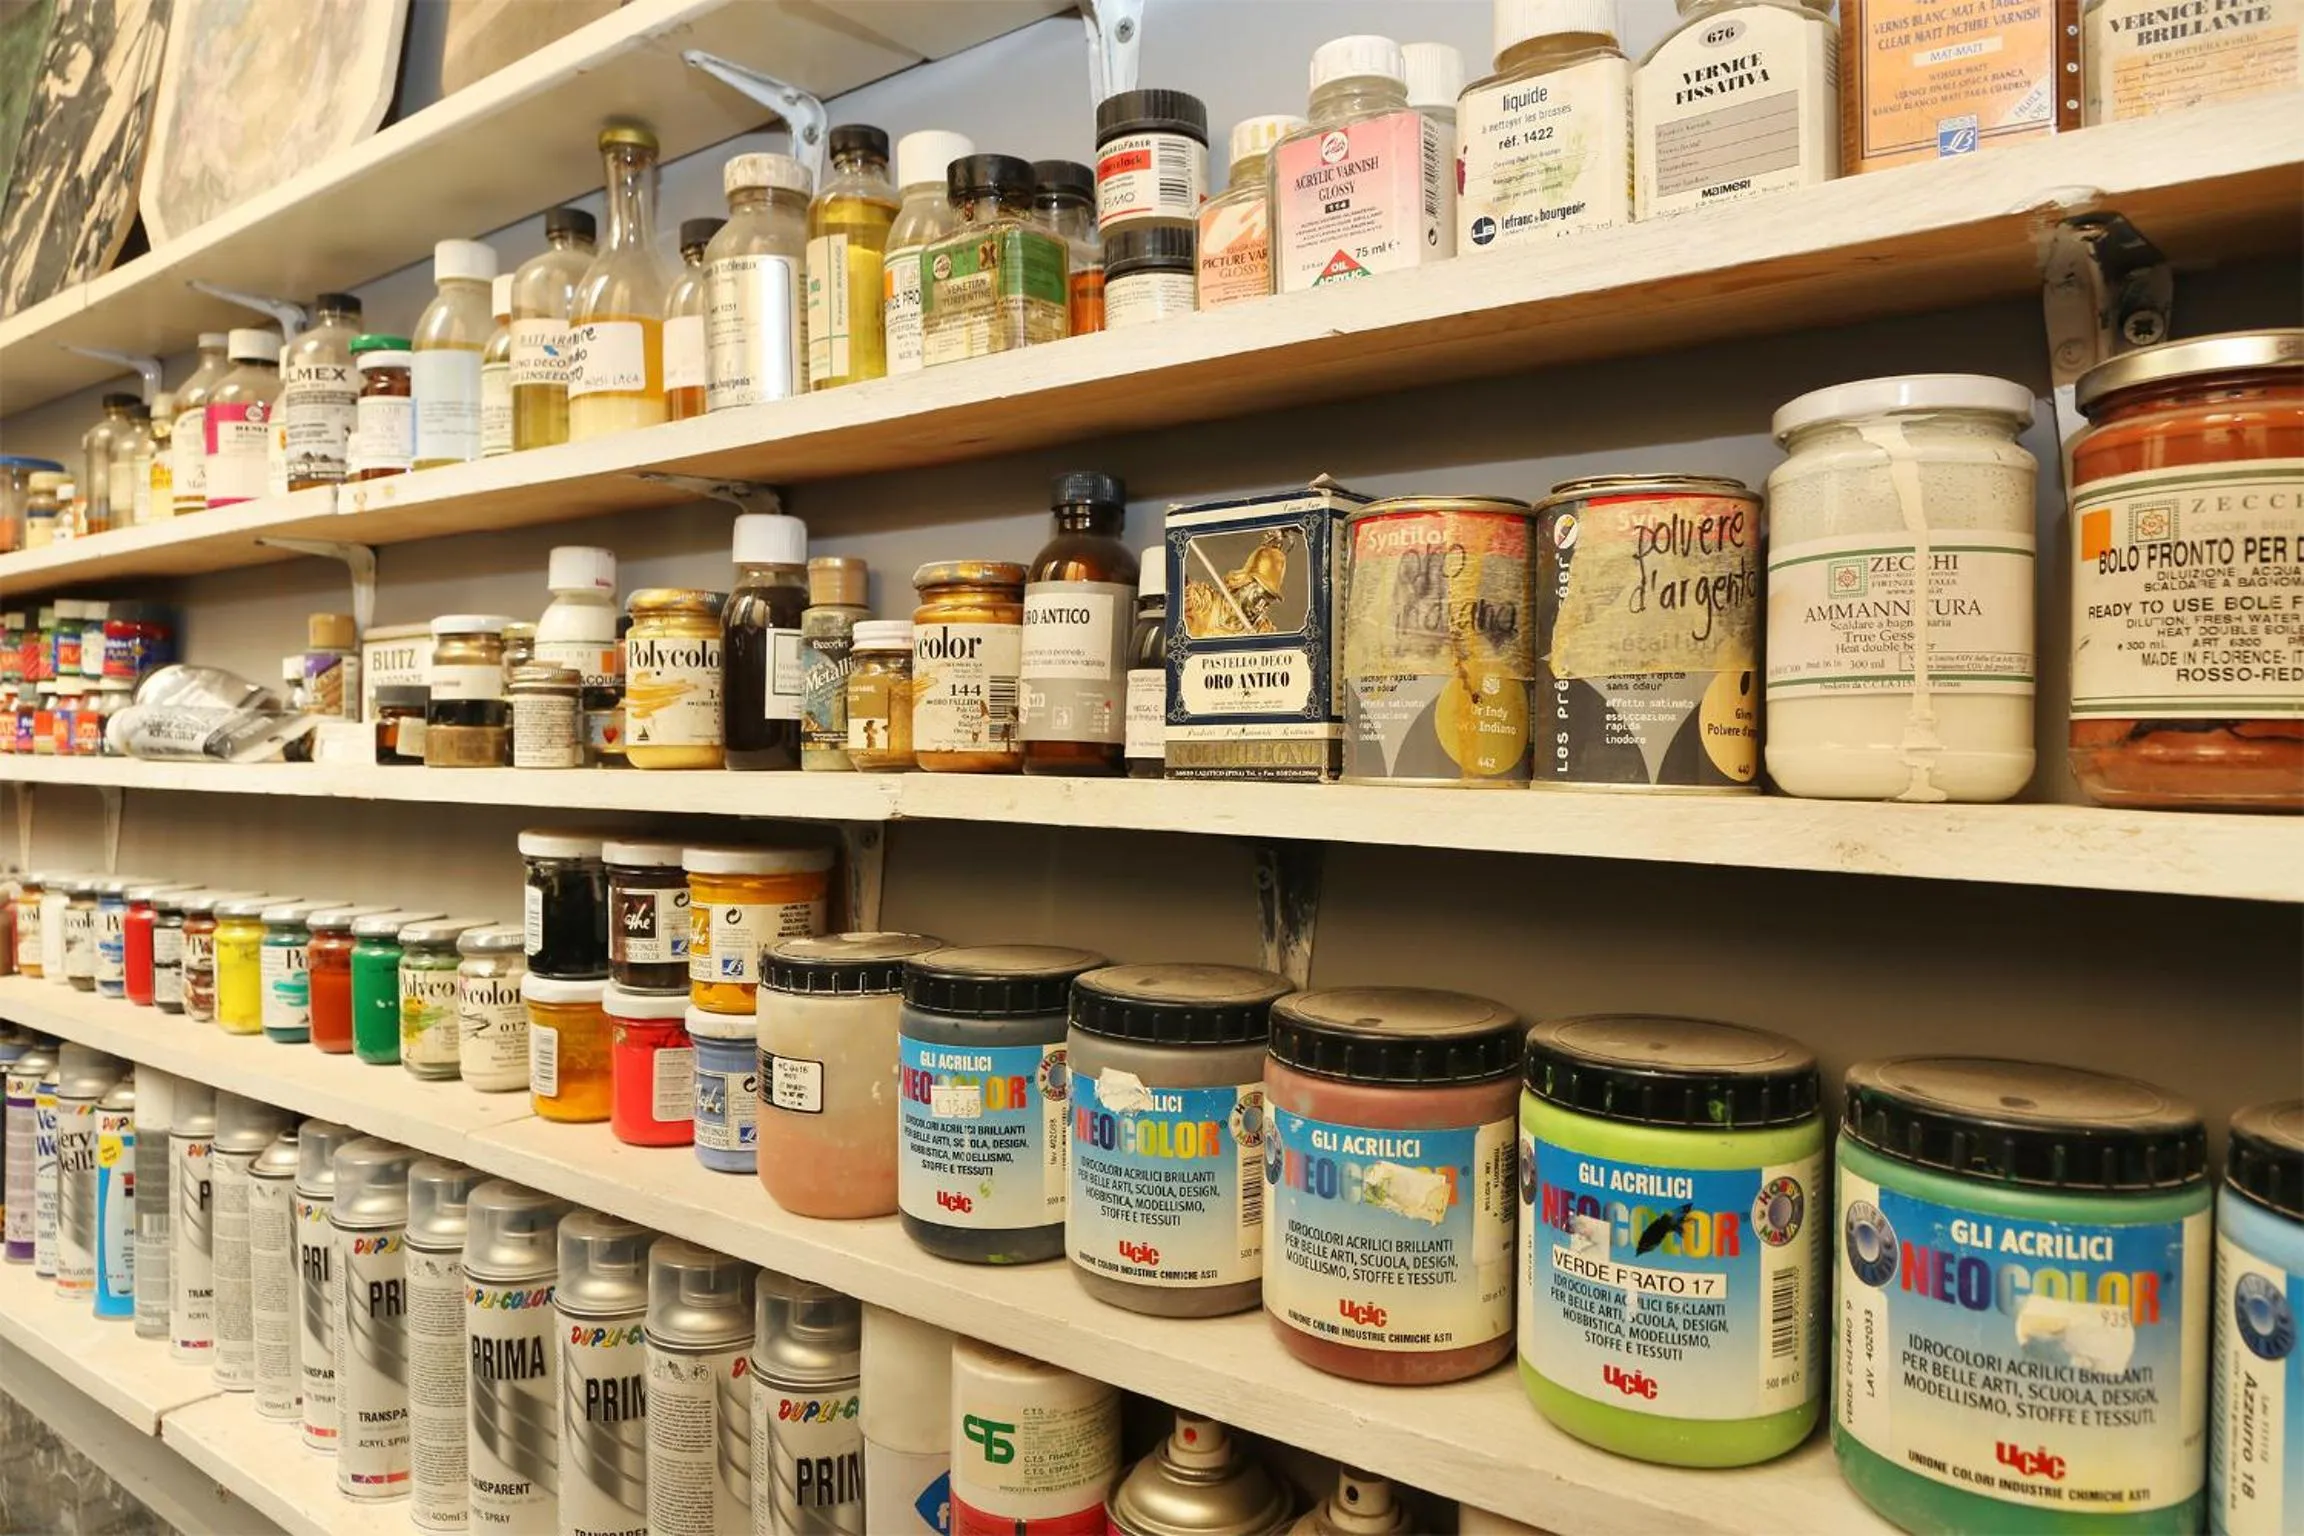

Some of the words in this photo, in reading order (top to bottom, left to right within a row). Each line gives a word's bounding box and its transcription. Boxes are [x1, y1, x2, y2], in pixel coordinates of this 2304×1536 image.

[1878, 34, 1911, 50] CLEAR
[1914, 26, 1943, 43] MATT
[1946, 20, 1989, 37] PICTURE
[1993, 8, 2042, 27] VARNISH
[2109, 1, 2207, 32] VERNICE
[2137, 5, 2271, 46] BRILLANTE
[1707, 27, 1735, 44] 676
[1683, 52, 1763, 85] VERNICE
[1503, 86, 1548, 112] liquide
[1676, 68, 1770, 105] FISSATIVA
[1524, 127, 1554, 144] 1422
[1294, 171, 1335, 191] ACRYLIC
[1337, 156, 1380, 181] VARNISH
[1318, 181, 1355, 201] GLOSSY
[1202, 253, 1246, 269] PICTURE
[1356, 247, 1368, 259] 75
[1372, 242, 1386, 255] ml
[1633, 506, 1745, 559] polvere
[2099, 545, 2139, 575] BOLO
[2244, 536, 2287, 563] PER
[2088, 602, 2132, 619] READY
[2140, 600, 2164, 614] TO
[2172, 597, 2214, 613] USE
[2225, 596, 2283, 611] BOLE
[914, 626, 982, 659] color
[1843, 632, 1876, 643] True
[1880, 630, 1915, 642] Gess
[2157, 626, 2192, 636] HEAT
[2200, 625, 2258, 635] DOUBLE
[2192, 638, 2219, 648] ART
[2229, 638, 2262, 647] 6300
[373, 649, 415, 670] BLITZ
[1863, 641, 1900, 652] double
[2142, 652, 2177, 666] MADE
[2183, 652, 2196, 665] IN
[950, 684, 981, 696] 144
[1204, 674, 1233, 689] ORO
[1240, 672, 1289, 689] ANTICO
[1605, 735, 1647, 745] inodore
[920, 1050, 936, 1067] GLI
[938, 1054, 992, 1072] ACRILICI
[1075, 1107, 1220, 1159] NEOCOLOR
[1312, 1129, 1337, 1152] GLI
[1342, 1135, 1421, 1158] ACRILICI
[921, 1159, 948, 1173] STOFFE
[950, 1163, 954, 1174] E
[957, 1166, 993, 1176] TESSUTI
[1081, 1155, 1122, 1176] IDROCOLORI
[1124, 1168, 1162, 1182] ACRILICI
[1164, 1171, 1215, 1182] BRILLANTI
[1578, 1161, 1605, 1189] GLI
[1610, 1169, 1693, 1200] ACRILICI
[1089, 1174, 1110, 1189] BELLE
[1111, 1179, 1133, 1195] ARTI,
[1135, 1184, 1178, 1199] SCUOLA,
[1101, 1208, 1130, 1222] STOFFE
[1133, 1214, 1138, 1223] E
[1140, 1215, 1181, 1226] TESSUTI
[1135, 1198, 1205, 1213] MODELLISMO,
[1288, 1219, 1344, 1247] IDROCOLORI
[1346, 1235, 1393, 1251] ACRILICI
[1396, 1238, 1453, 1253] BRILLANTI
[1951, 1218, 1992, 1250] GLI
[2000, 1228, 2114, 1262] ACRILICI
[1285, 1233, 1300, 1250] PER
[1301, 1239, 1328, 1257] BELLE
[1331, 1249, 1357, 1266] ARTI,
[1360, 1254, 1410, 1269] SCUOLA,
[1121, 1266, 1157, 1279] INDUSTRIE
[1160, 1271, 1199, 1280] CHIMICHE
[1201, 1270, 1218, 1279] ASTI
[1285, 1249, 1350, 1281] MODELLISMO,
[1353, 1268, 1394, 1285] STOFFE
[1397, 1273, 1404, 1285] E
[1554, 1250, 1610, 1282] VERDE
[1617, 1267, 1685, 1294] PRATO
[1692, 1279, 1715, 1296] 17
[1550, 1286, 1566, 1306] PER
[1568, 1293, 1595, 1314] BELLE
[1598, 1304, 1625, 1322] ARTI,
[1554, 1272, 1611, 1304] IDROCOLORI
[1614, 1293, 1665, 1314] ACILICI
[1288, 1308, 1312, 1327] UNIONE
[1313, 1318, 1339, 1335] COLORI
[1342, 1326, 1386, 1343] INDUSTRIE
[1388, 1332, 1431, 1344] CHIMICHE
[1434, 1332, 1453, 1343] ASTI
[1562, 1307, 1625, 1338] HOBBISTICA,
[1629, 1326, 1711, 1350] MODELLISMO,
[472, 1334, 547, 1380] PRIMA
[1585, 1332, 1622, 1352] STOFFE
[1626, 1341, 1633, 1354] E
[1636, 1343, 1683, 1361] TESSUTI
[1908, 1332, 2002, 1374] IDROCOLORI
[2006, 1361, 2075, 1384] ACRILICI
[1866, 1375, 1876, 1399] LAV
[1902, 1351, 1928, 1375] PER
[1931, 1361, 1976, 1388] BELLE
[1981, 1376, 2024, 1400] ARTI,
[2028, 1385, 2098, 1408] SCUOLA,
[1903, 1371, 2012, 1419] MODELLISMO,
[2016, 1402, 2076, 1425] STOFFE
[2081, 1410, 2090, 1426] E
[1908, 1449, 1948, 1475] UNIONE
[1952, 1466, 1995, 1488] COLORI
[1999, 1478, 2063, 1500] INDUSTRIE
[2068, 1488, 2124, 1502] CHIMICHE
[2129, 1488, 2151, 1501] ASTI
[2242, 1474, 2256, 1501] 18
[485, 1510, 511, 1525] SPRAY
